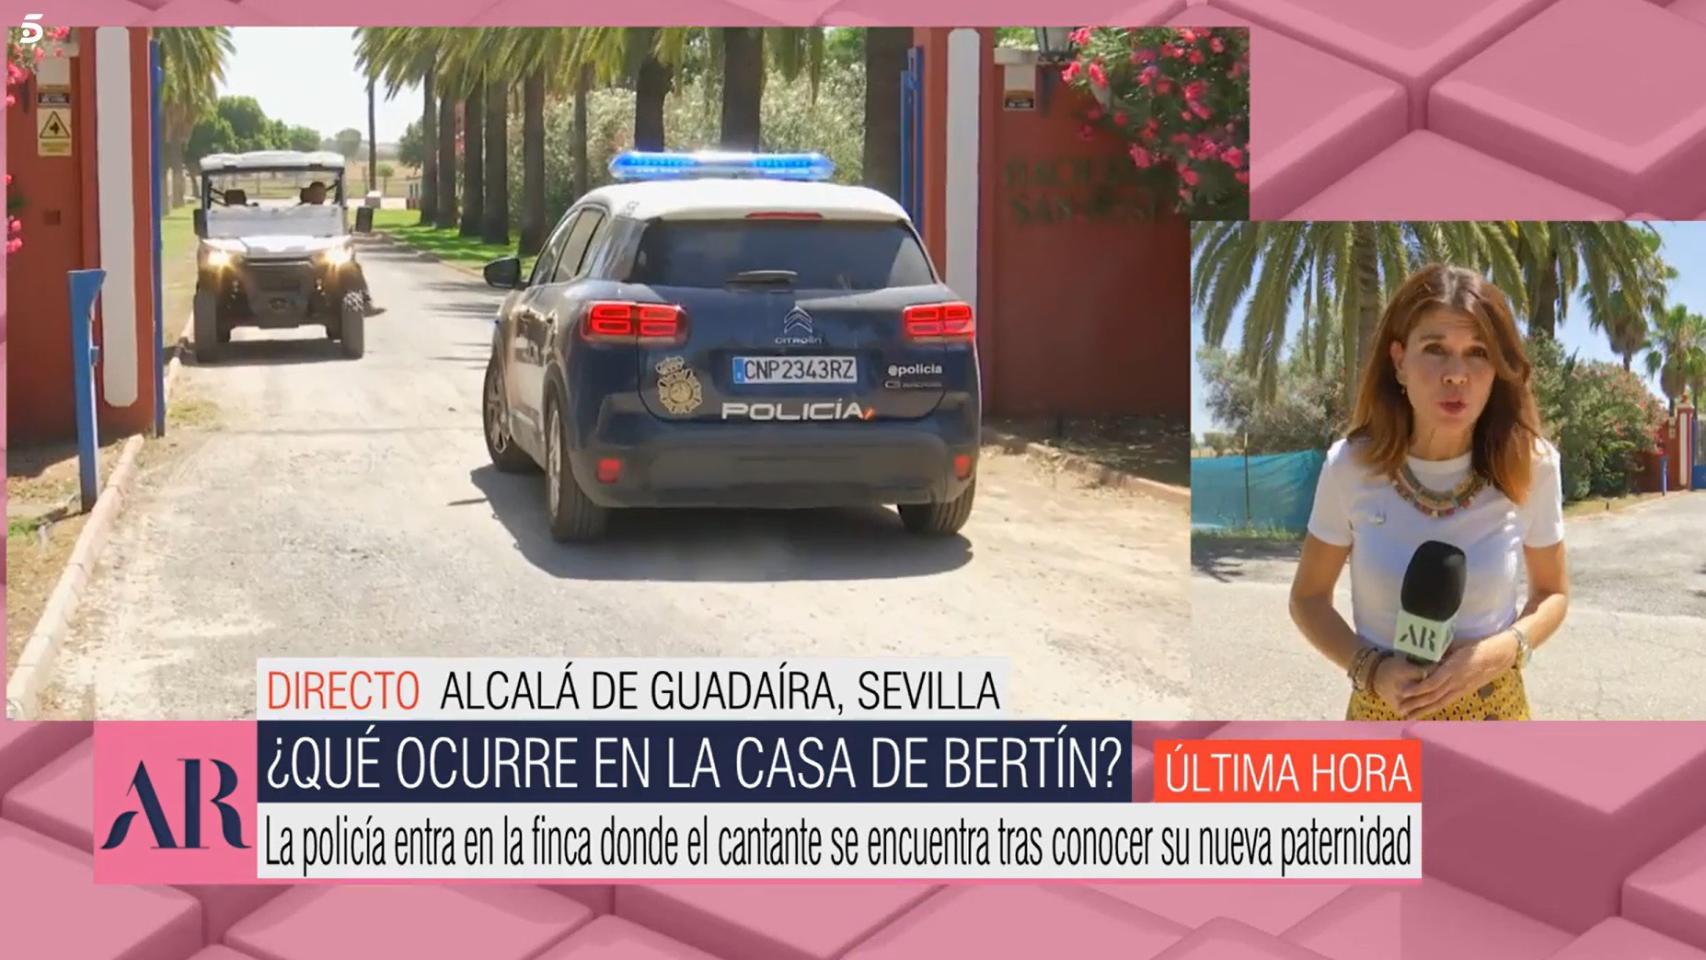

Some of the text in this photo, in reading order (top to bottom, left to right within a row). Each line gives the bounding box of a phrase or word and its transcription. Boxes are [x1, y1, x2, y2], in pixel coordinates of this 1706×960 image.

[744, 359, 854, 380] CNP2343RZ
[721, 398, 864, 420] POLICÍA
[1399, 623, 1436, 652] AR
